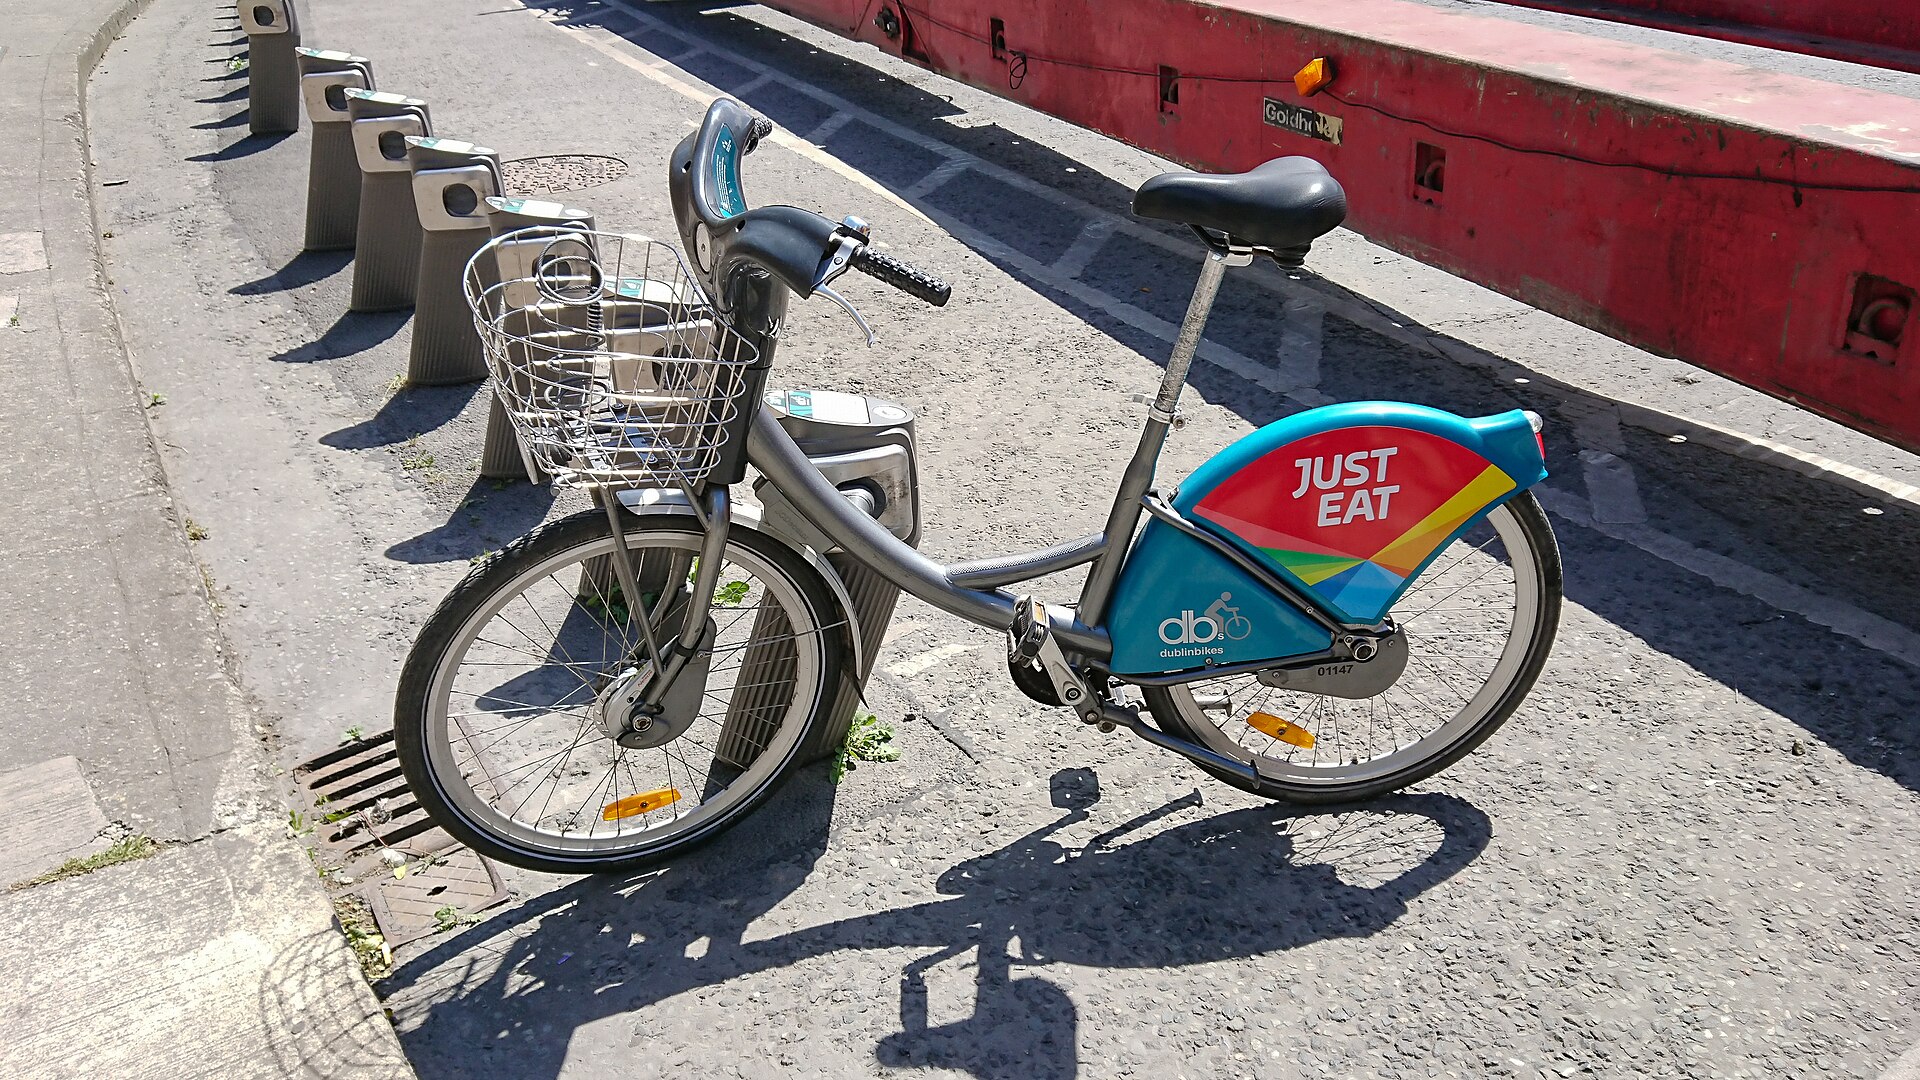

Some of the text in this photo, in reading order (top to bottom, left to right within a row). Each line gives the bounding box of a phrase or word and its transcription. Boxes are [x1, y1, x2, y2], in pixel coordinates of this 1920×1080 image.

[1292, 447, 1398, 499] JUST
[1317, 485, 1400, 527] EAT
[1159, 646, 1224, 658] dublinbikes
[1317, 664, 1354, 676] 01147
